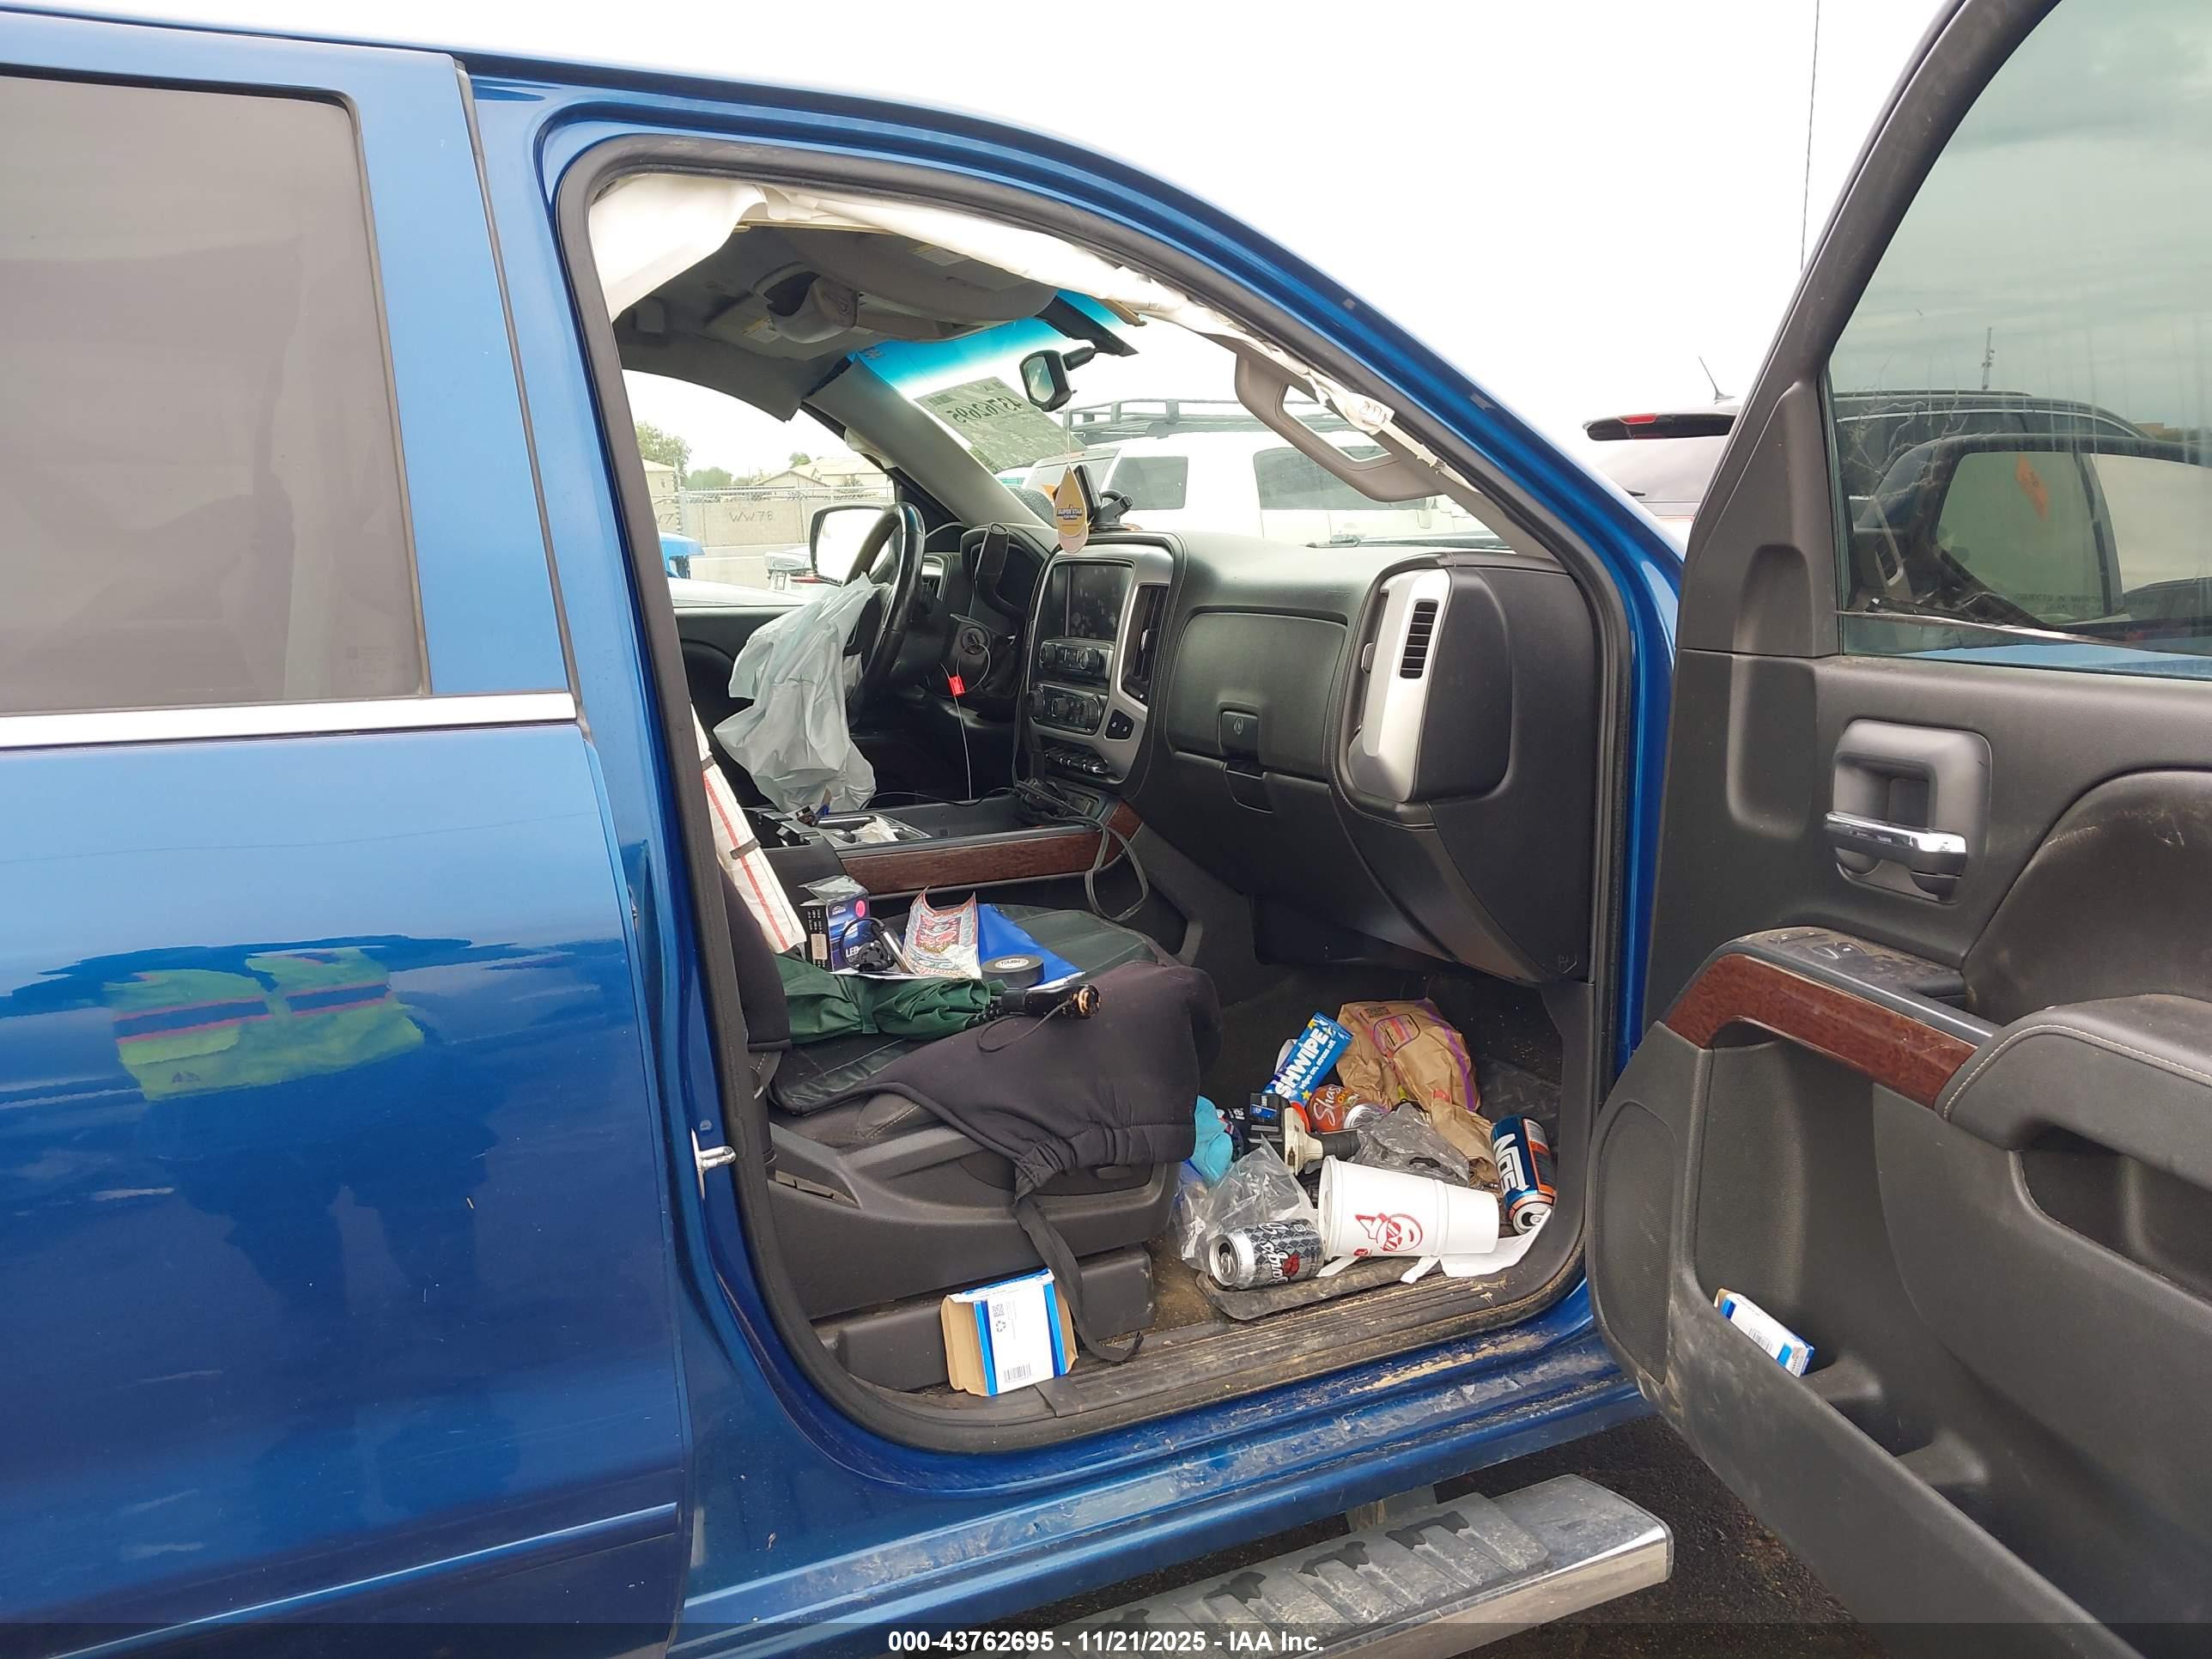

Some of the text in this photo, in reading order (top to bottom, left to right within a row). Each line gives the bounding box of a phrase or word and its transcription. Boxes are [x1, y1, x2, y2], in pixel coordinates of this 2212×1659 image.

[845, 945, 860, 958] LED
[1275, 1028, 1329, 1098] SHWIPE
[1493, 1133, 1531, 1195] NOS
